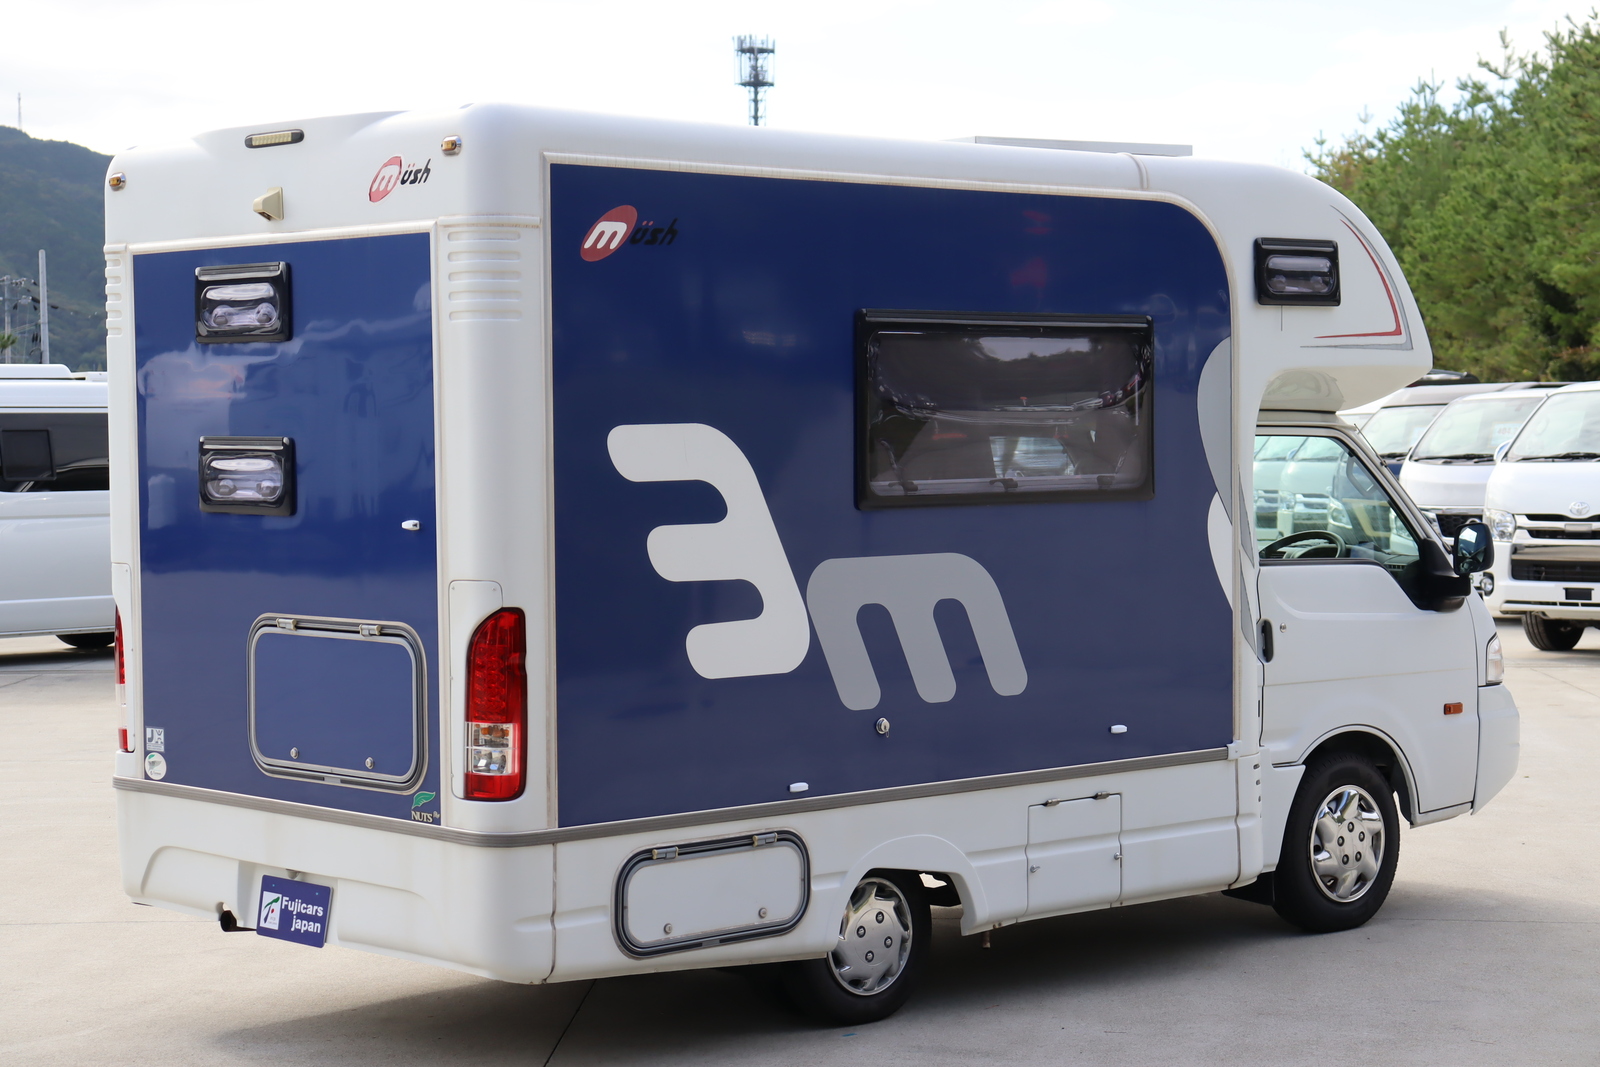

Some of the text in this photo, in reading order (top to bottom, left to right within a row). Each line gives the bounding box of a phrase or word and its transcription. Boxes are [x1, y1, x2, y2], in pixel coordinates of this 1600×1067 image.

[411, 810, 433, 823] NUTS
[281, 896, 324, 917] Fujicars
[290, 915, 321, 934] japan
